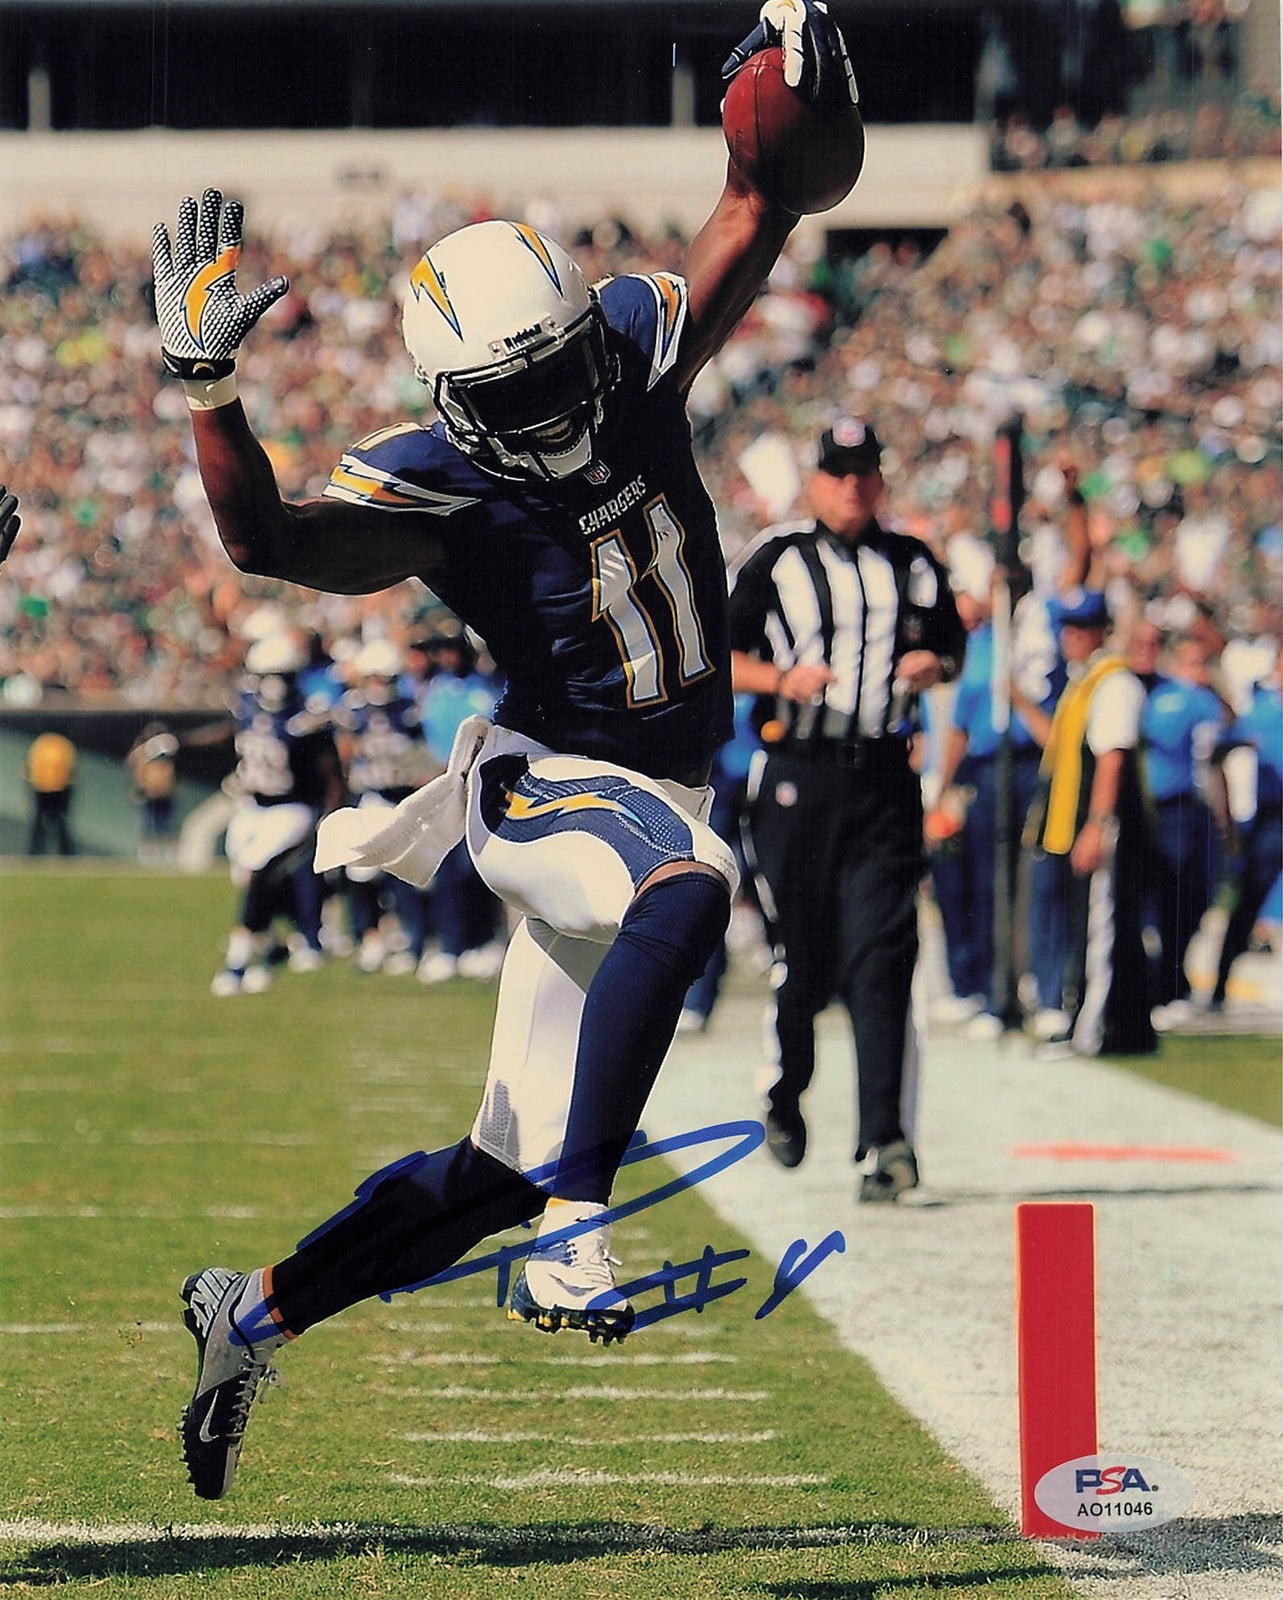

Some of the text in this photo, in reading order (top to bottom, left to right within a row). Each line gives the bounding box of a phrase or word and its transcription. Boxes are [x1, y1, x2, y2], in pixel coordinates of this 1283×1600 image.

[503, 323, 543, 351] Riddell
[578, 474, 647, 535] CHARGERS
[589, 491, 716, 709] 11
